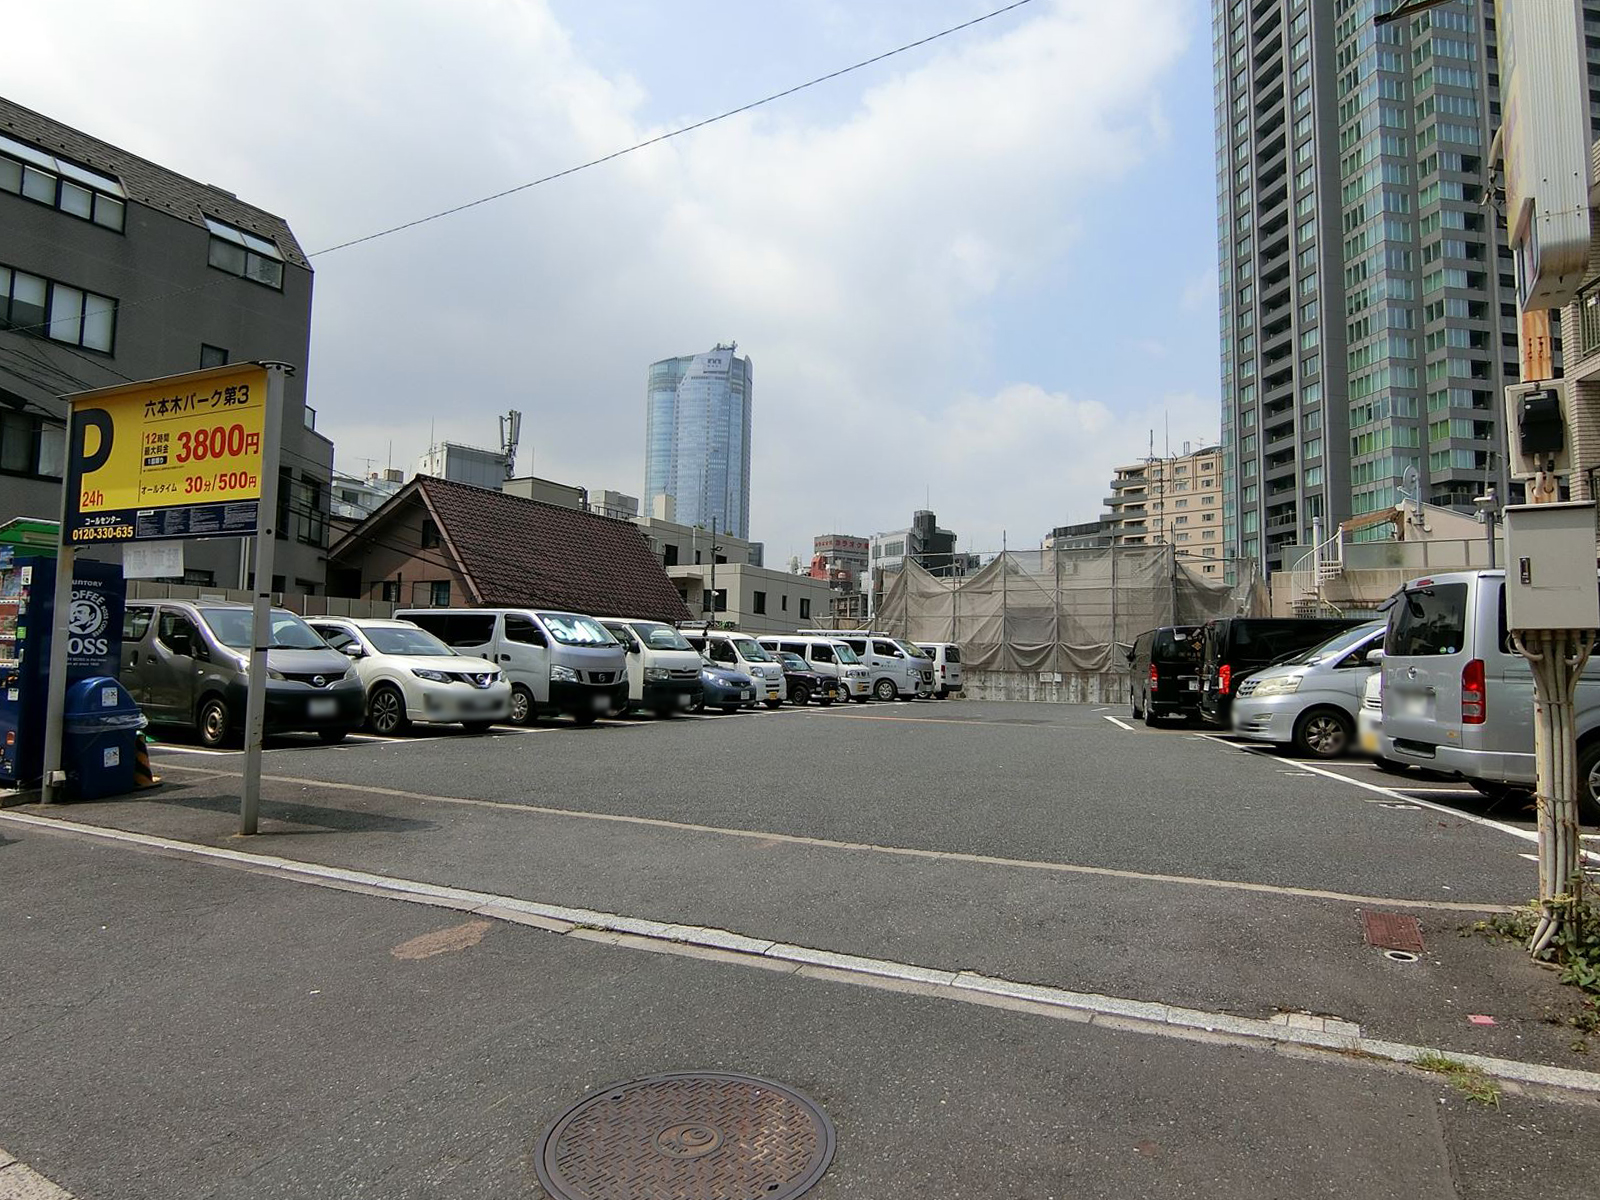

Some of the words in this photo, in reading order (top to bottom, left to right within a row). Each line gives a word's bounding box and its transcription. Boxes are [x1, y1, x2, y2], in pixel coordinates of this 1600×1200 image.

[144, 384, 250, 419] 六本木パーク第3
[145, 432, 170, 445] 12時間
[175, 423, 260, 464] 3800円
[71, 408, 115, 509] P
[141, 482, 178, 495] オールタイム
[184, 471, 257, 495] 30分/500円
[81, 490, 104, 508] 24h
[84, 515, 122, 526] コールセンター
[72, 525, 134, 541] 0120-330-635
[72, 579, 103, 588] UNTORY
[71, 590, 106, 606] OFFEE
[68, 637, 109, 656] OSS
